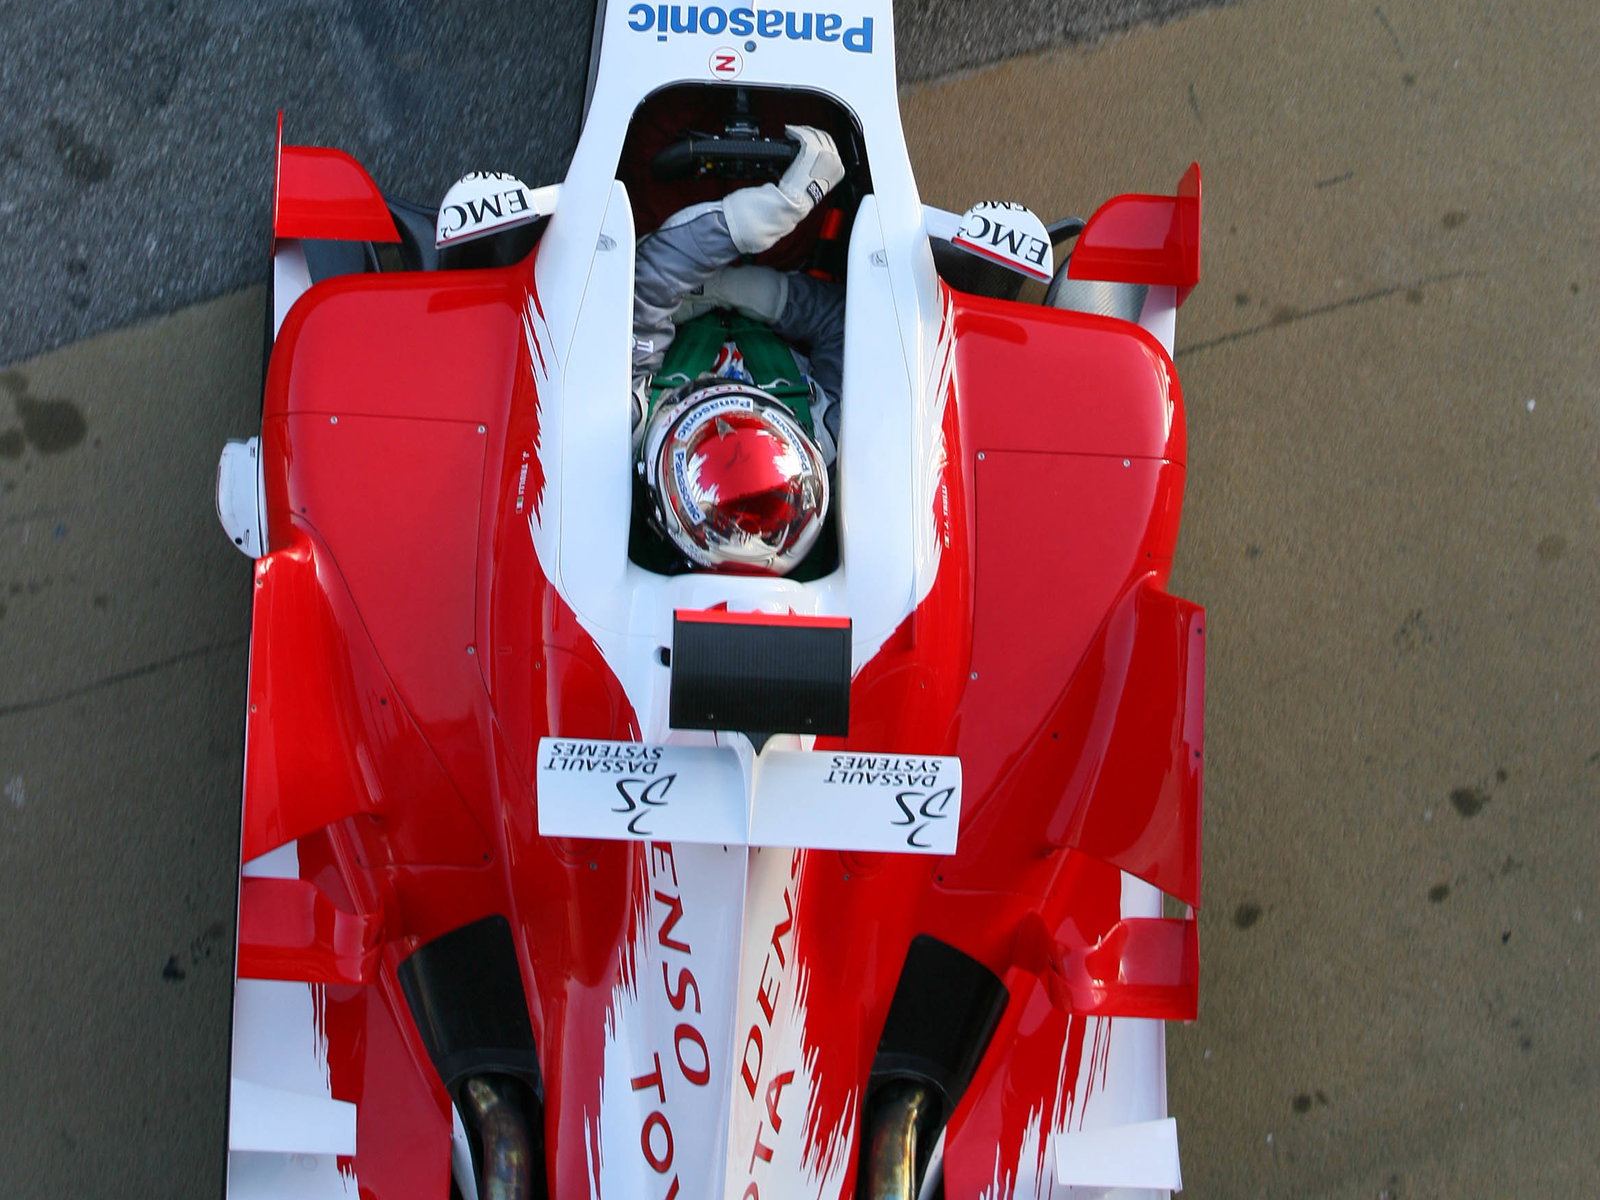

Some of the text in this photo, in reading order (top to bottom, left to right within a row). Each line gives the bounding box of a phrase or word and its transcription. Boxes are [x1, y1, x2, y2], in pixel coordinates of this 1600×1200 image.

[627, 3, 874, 54] Panasonic
[551, 742, 664, 760] SYSTEMES
[543, 756, 659, 775] DASSAULT
[830, 755, 942, 773] SYSTEMES
[823, 769, 938, 788] DASSAULT
[651, 841, 711, 1087] ENSO
[740, 847, 800, 1101] DENS
